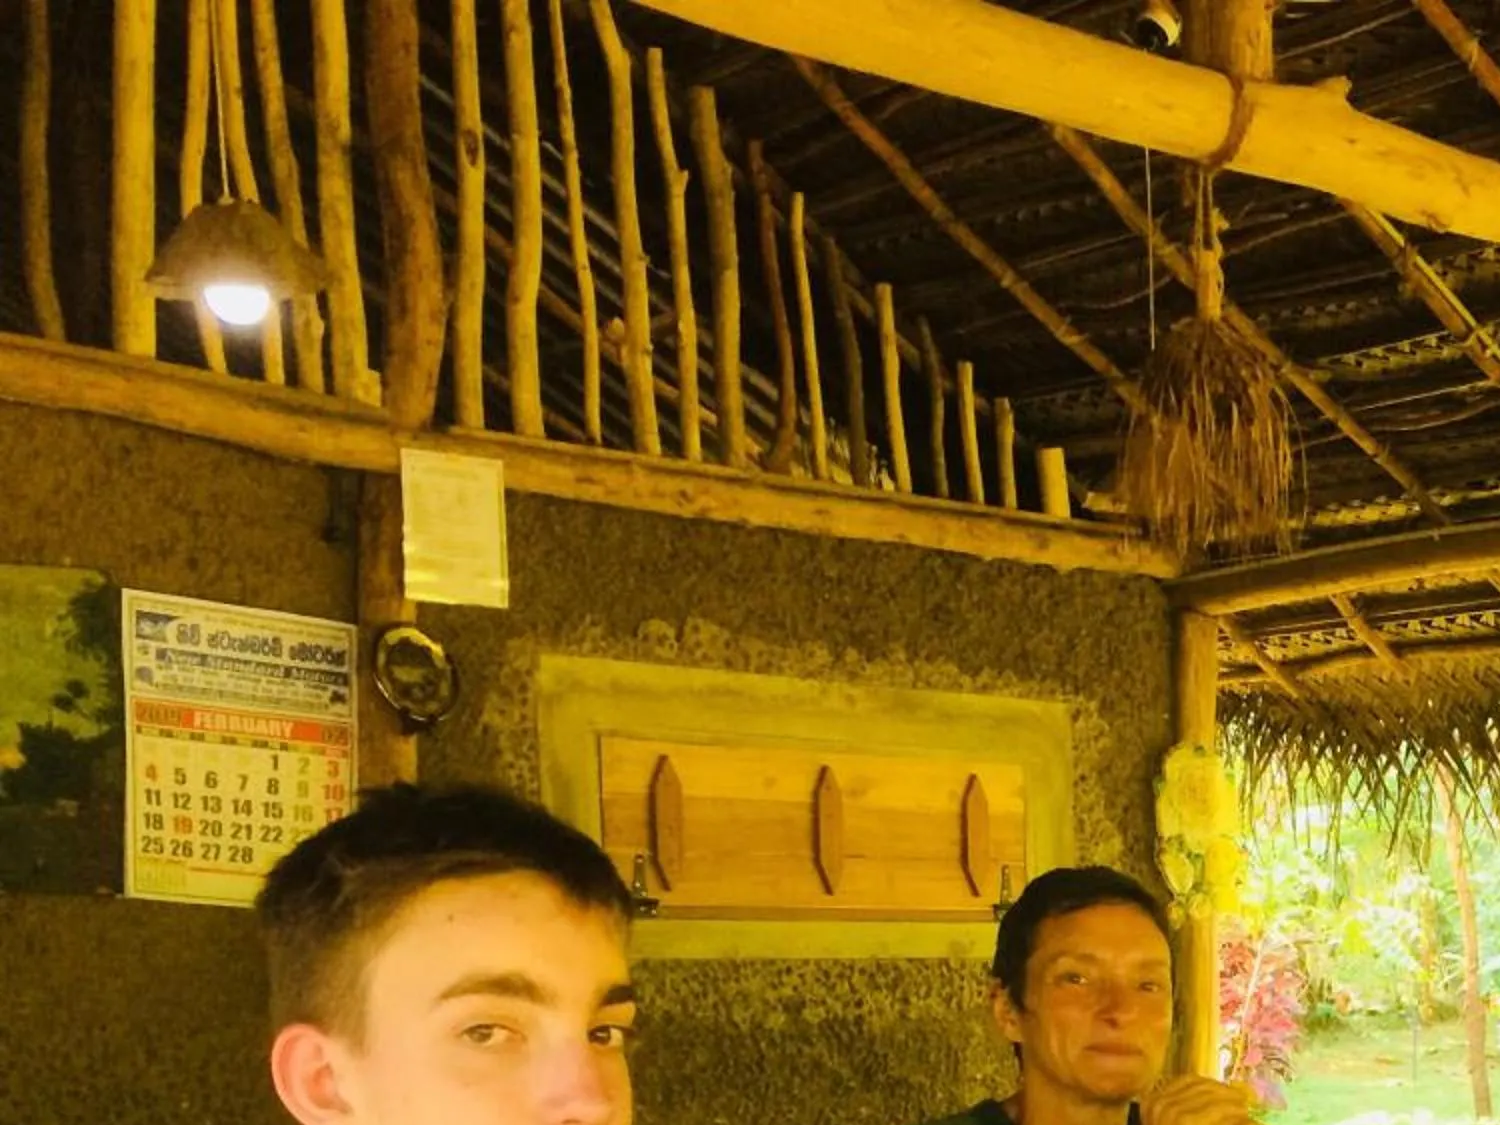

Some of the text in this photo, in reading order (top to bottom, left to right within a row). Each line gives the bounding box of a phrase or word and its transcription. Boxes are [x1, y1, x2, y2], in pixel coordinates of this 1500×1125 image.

[194, 710, 294, 738] FEBRUARY
[271, 754, 340, 777] 1 2 3
[145, 763, 345, 801] 4 5 6 7 8 9 10
[144, 788, 161, 807] 11
[172, 792, 192, 811] 12
[200, 795, 222, 814] 13
[231, 798, 253, 817] 14
[261, 801, 283, 820] 15
[292, 804, 313, 823] 16
[143, 812, 164, 831] 18
[172, 815, 193, 835] 19
[199, 819, 222, 837] 20
[229, 822, 252, 841] 21
[259, 825, 283, 844] 22
[141, 835, 253, 864] 25 26 27 28
